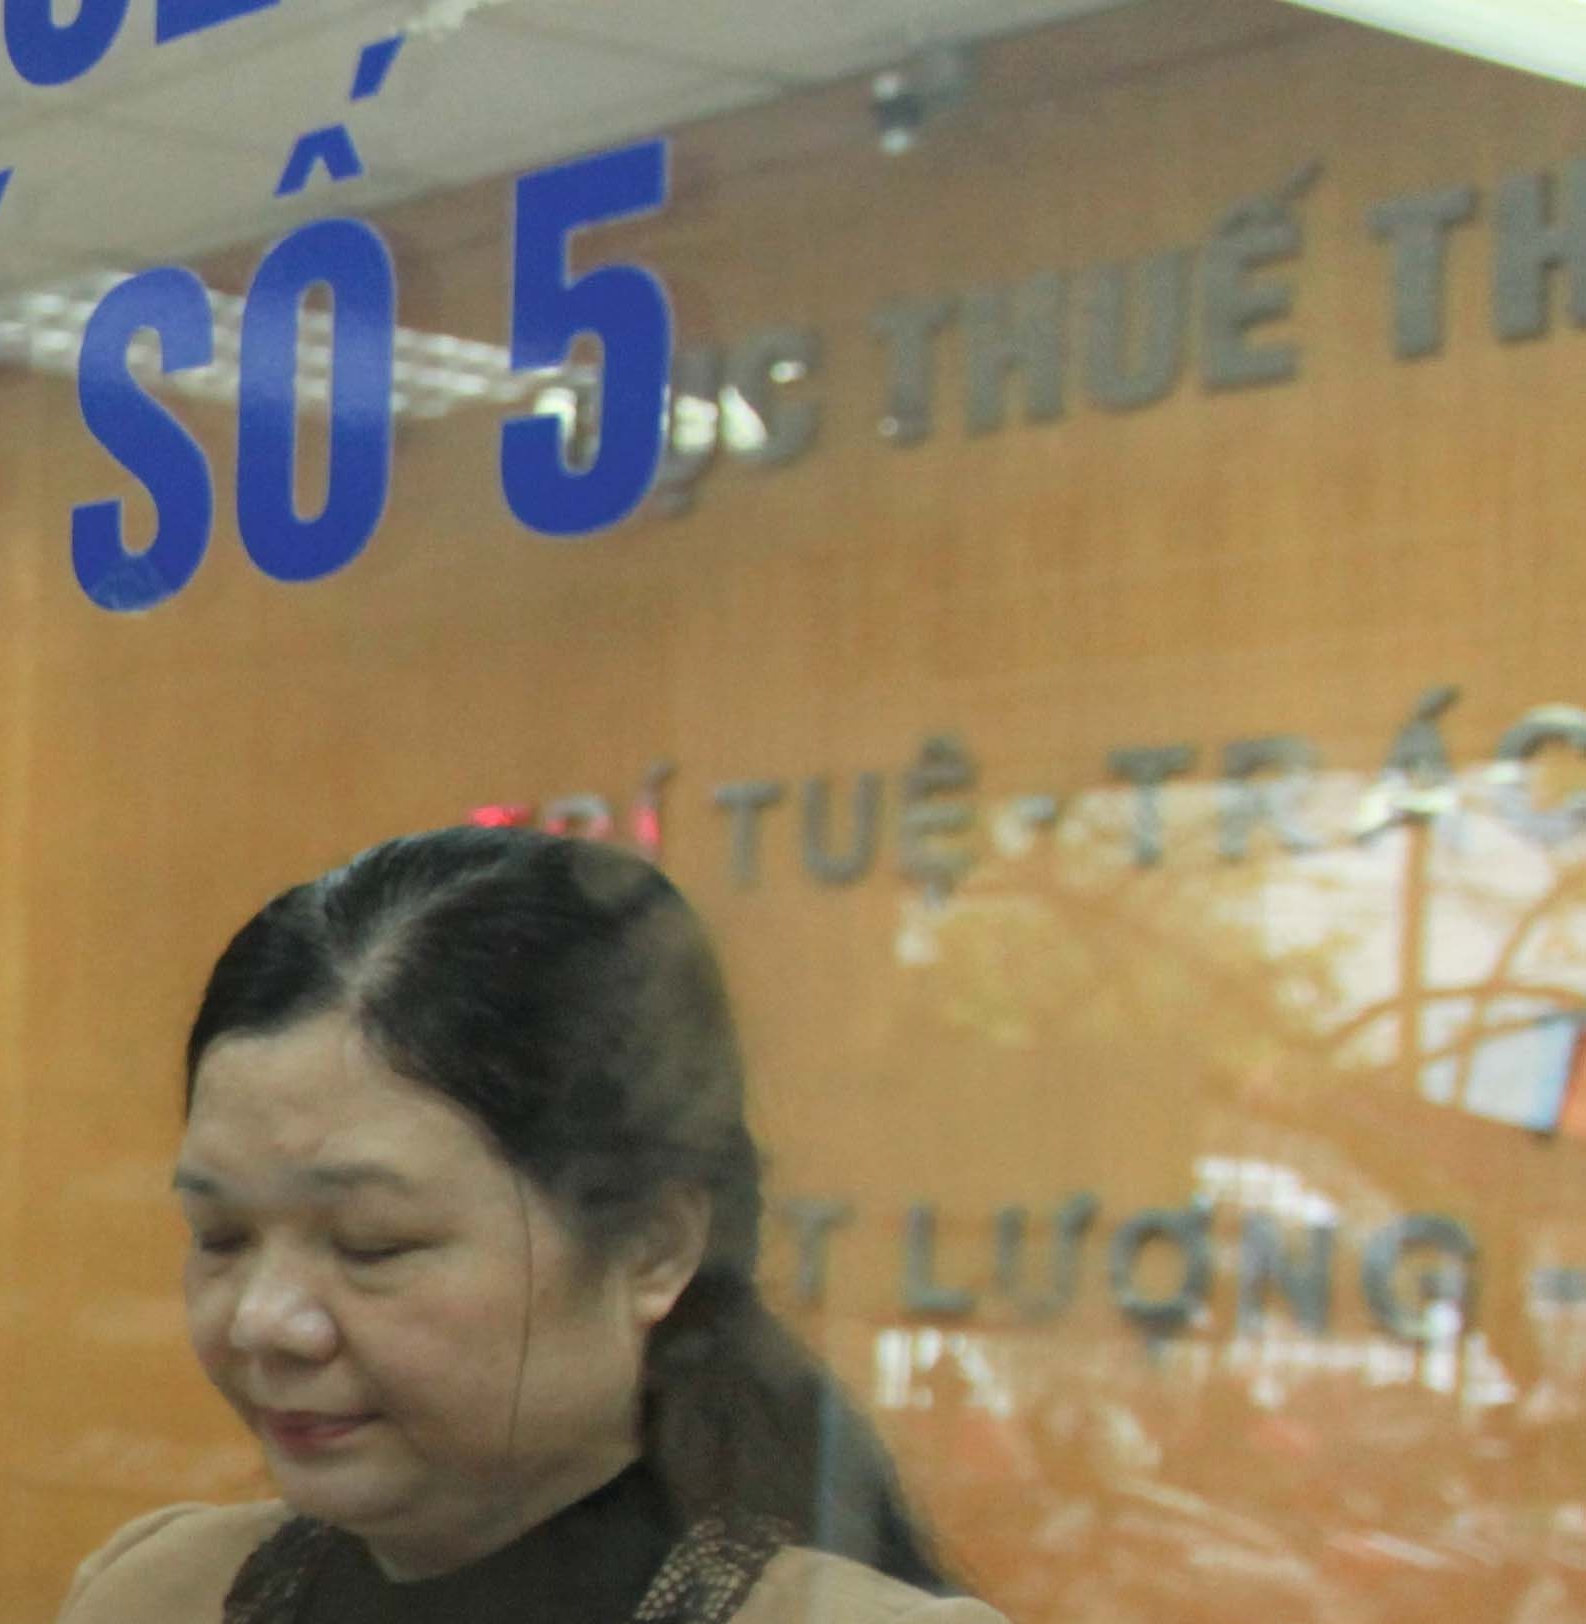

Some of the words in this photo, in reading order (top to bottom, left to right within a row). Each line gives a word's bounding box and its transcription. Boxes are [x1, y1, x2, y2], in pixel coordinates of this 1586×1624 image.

[70, 34, 406, 614] SỐ
[499, 137, 673, 539] 5
[870, 157, 1326, 448] THUẾ
[899, 1190, 1482, 1365] LƯỢNG
